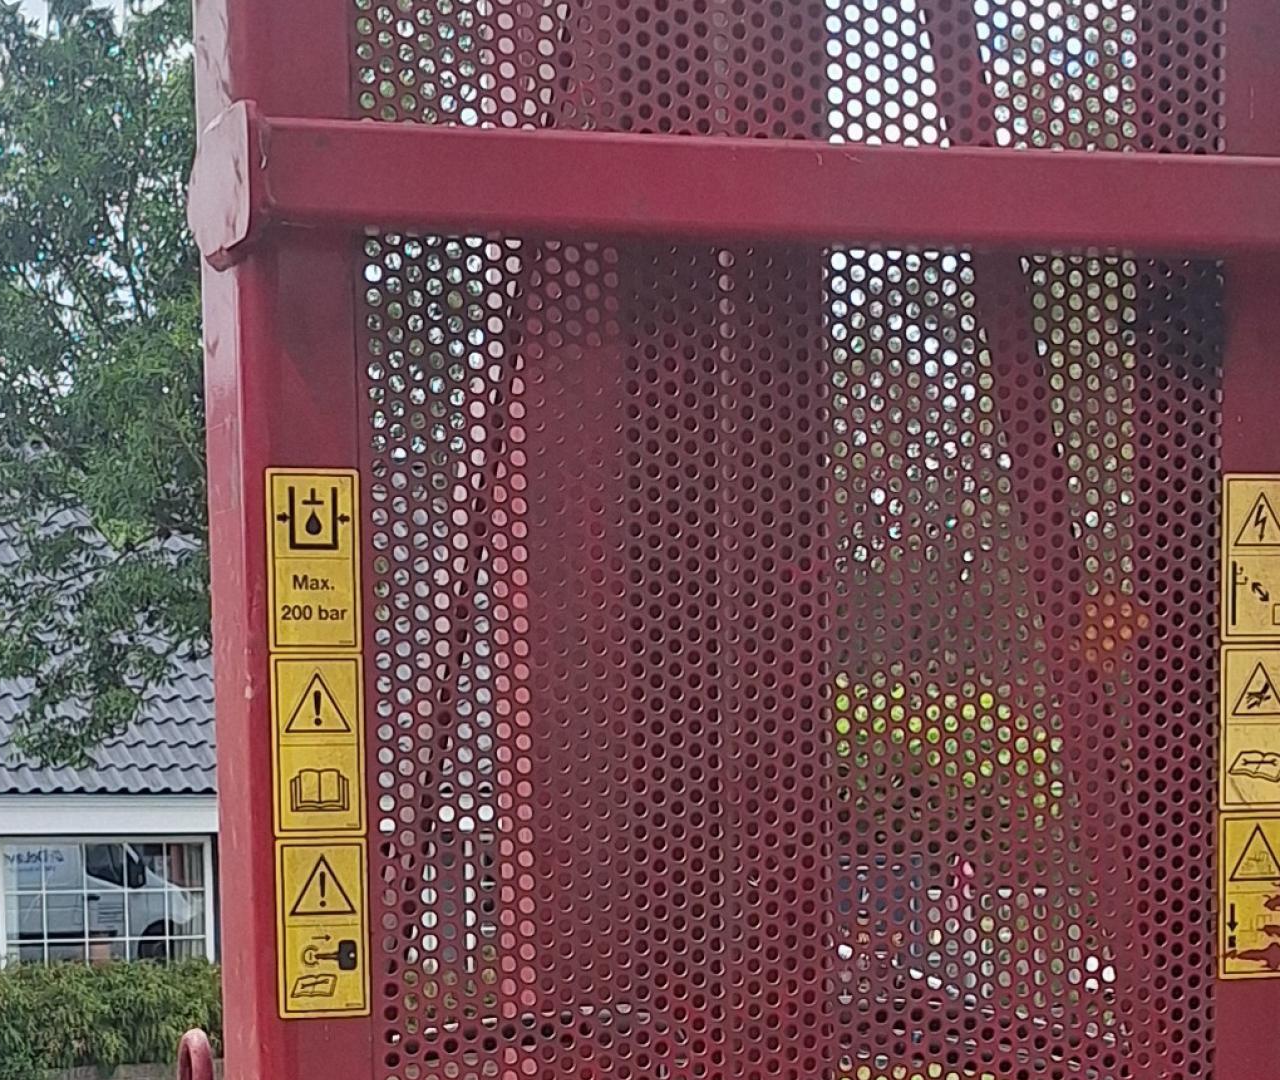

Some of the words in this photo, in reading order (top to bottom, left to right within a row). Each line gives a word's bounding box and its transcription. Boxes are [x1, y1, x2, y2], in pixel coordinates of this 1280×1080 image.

[292, 574, 335, 591] Max.
[281, 605, 312, 621] 200
[318, 604, 348, 621] bar
